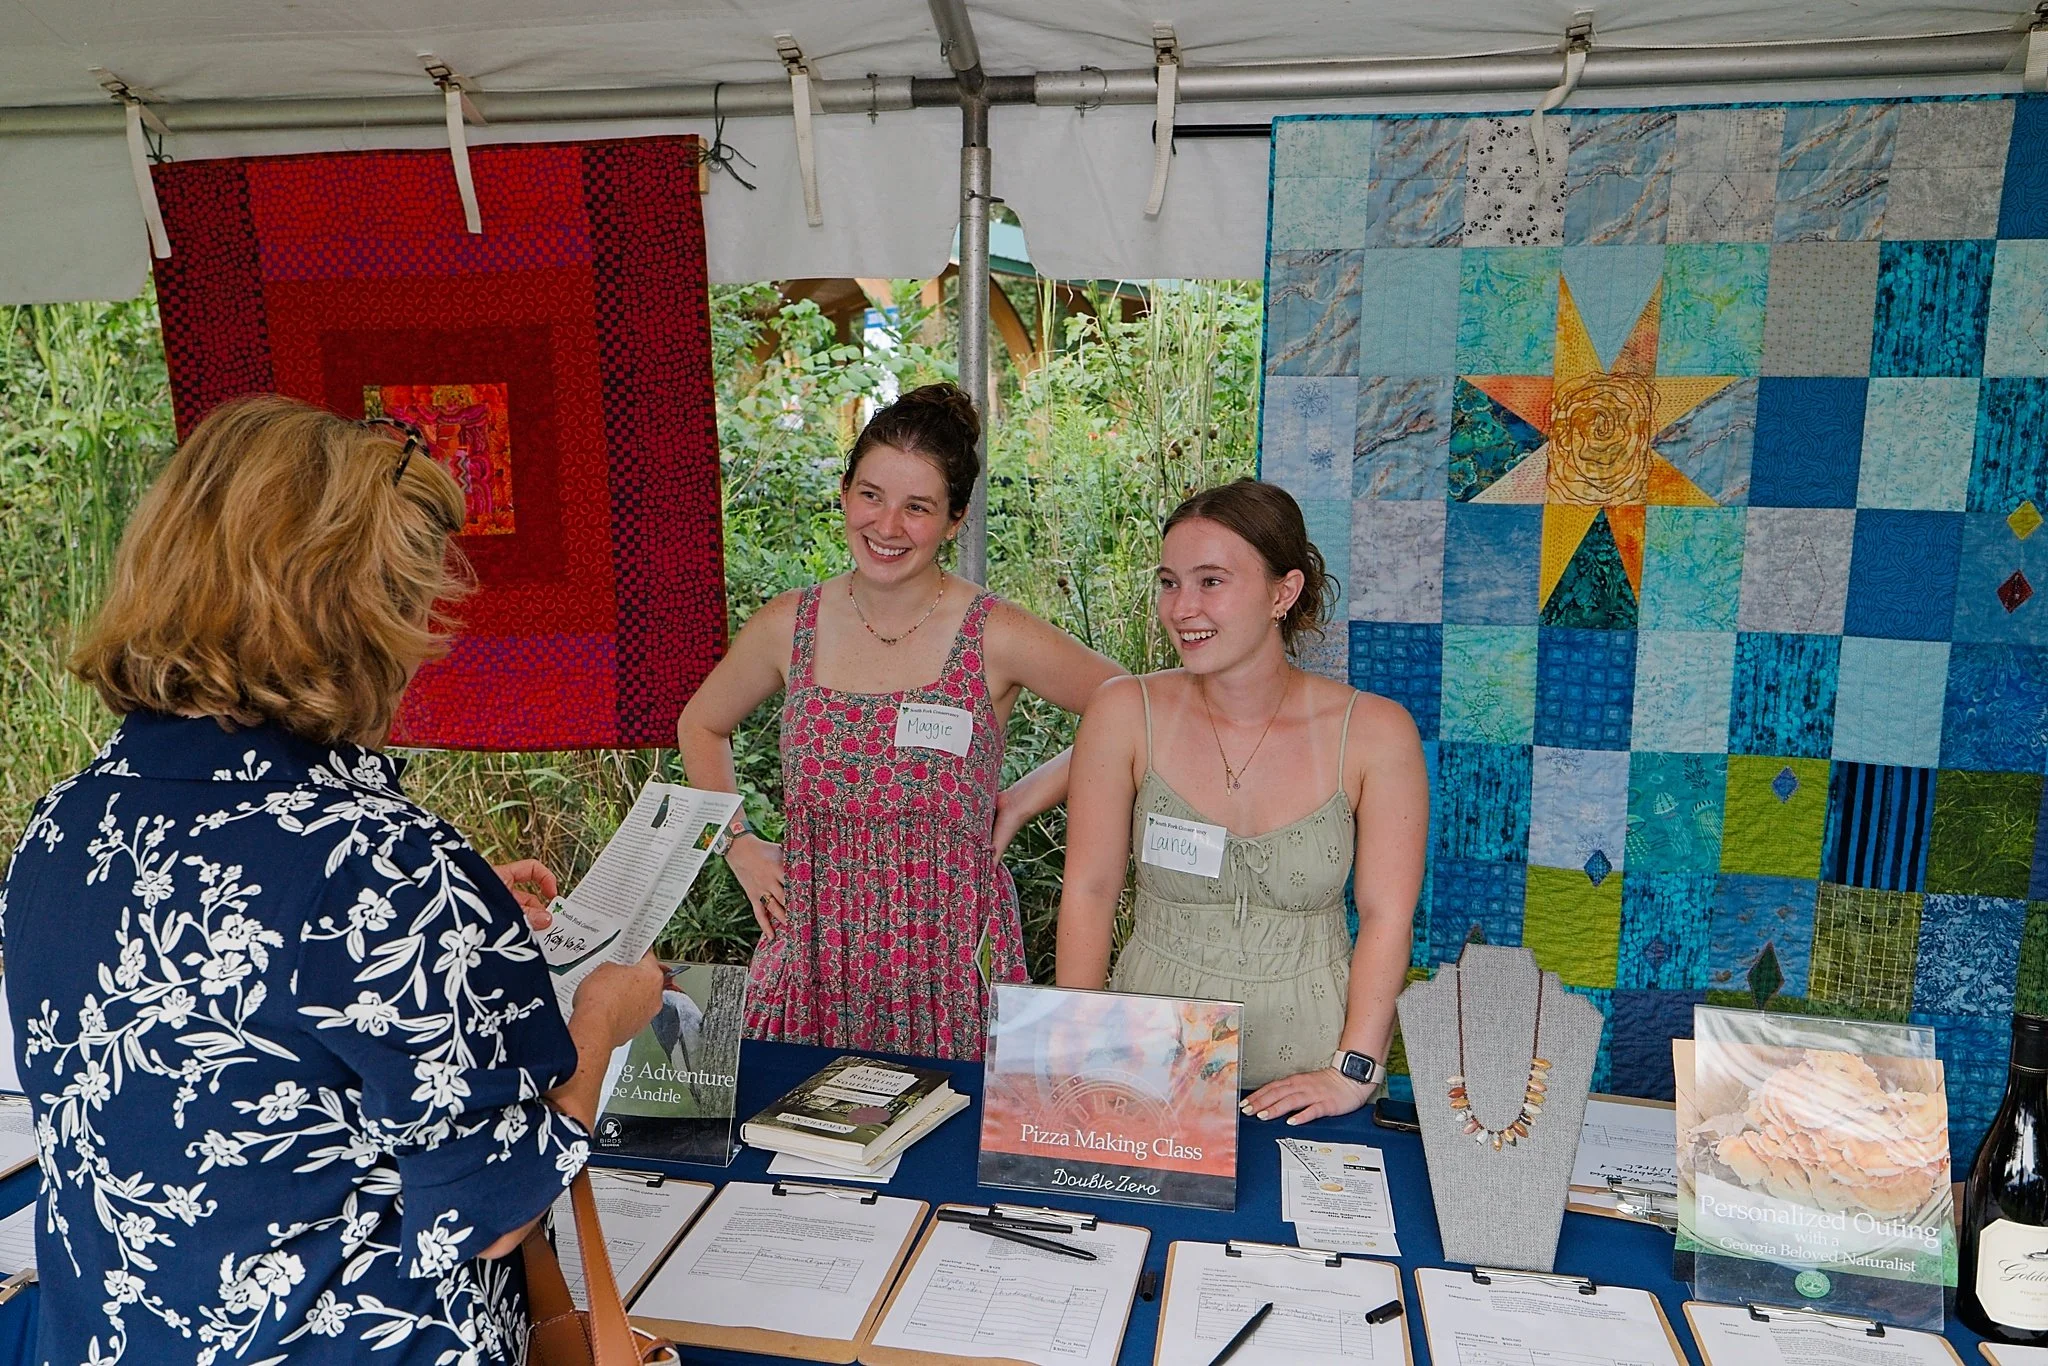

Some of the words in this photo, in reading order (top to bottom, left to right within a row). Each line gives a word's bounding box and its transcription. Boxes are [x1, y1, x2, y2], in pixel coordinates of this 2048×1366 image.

[908, 718, 952, 740] Maggie
[1150, 831, 1197, 866] Lainey
[638, 1062, 735, 1088] Adventure
[833, 1078, 900, 1094] Southward
[848, 1073, 900, 1087] Running
[874, 1070, 904, 1080] Road
[630, 1085, 681, 1104] Andrle
[804, 1119, 849, 1131] CHAPMAN
[1020, 1123, 1070, 1146] Pizza
[1074, 1130, 1148, 1160] Making
[1152, 1138, 1203, 1161] Class
[1051, 1168, 1117, 1192] Double
[1115, 1176, 1161, 1197] Zero
[1700, 1194, 1846, 1231] Personalized
[1853, 1212, 1940, 1248] Outing
[1794, 1230, 1827, 1245] with
[1831, 1238, 1840, 1246] a
[1720, 1236, 1776, 1256] Georgia
[1780, 1244, 1838, 1262] Beloved
[1843, 1251, 1917, 1272] Naturalist
